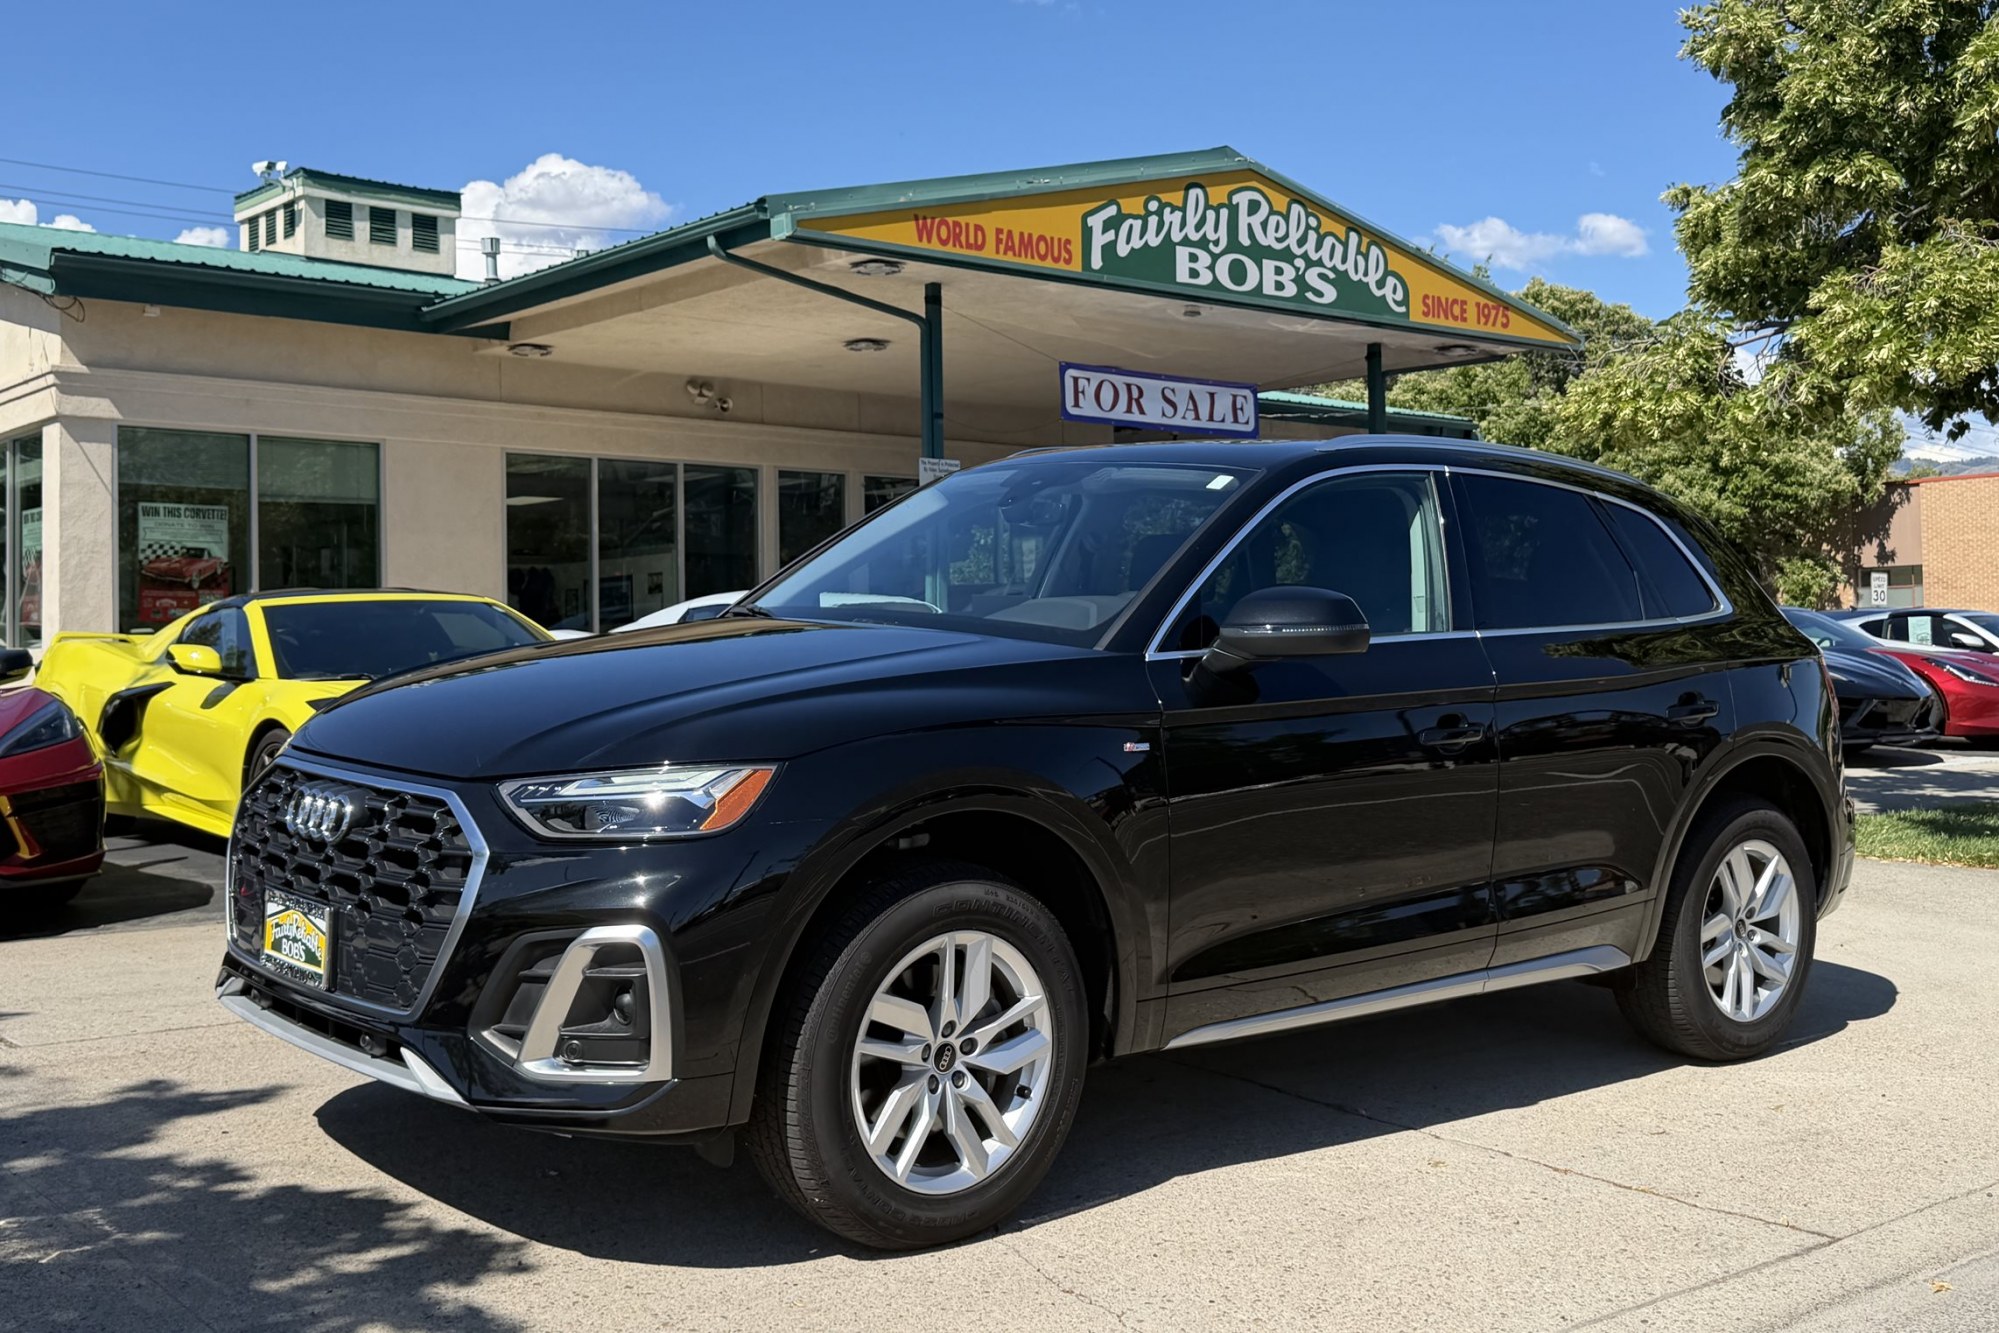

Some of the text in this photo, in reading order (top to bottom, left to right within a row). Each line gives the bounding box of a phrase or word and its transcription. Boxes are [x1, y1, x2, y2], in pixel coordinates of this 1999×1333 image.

[913, 213, 1073, 266] WORLD FAMOUS
[1086, 187, 1407, 313] Fairly Reliable
[1175, 245, 1338, 304] BOB'S
[1422, 293, 1510, 329] SINCE 1975
[1069, 375, 1250, 426] FOR SALE
[141, 505, 227, 520] WIN THIS CORVETTE!
[1873, 590, 1885, 602] 30
[271, 913, 323, 961] Fairly Reliable
[282, 938, 306, 962] BOB'S
